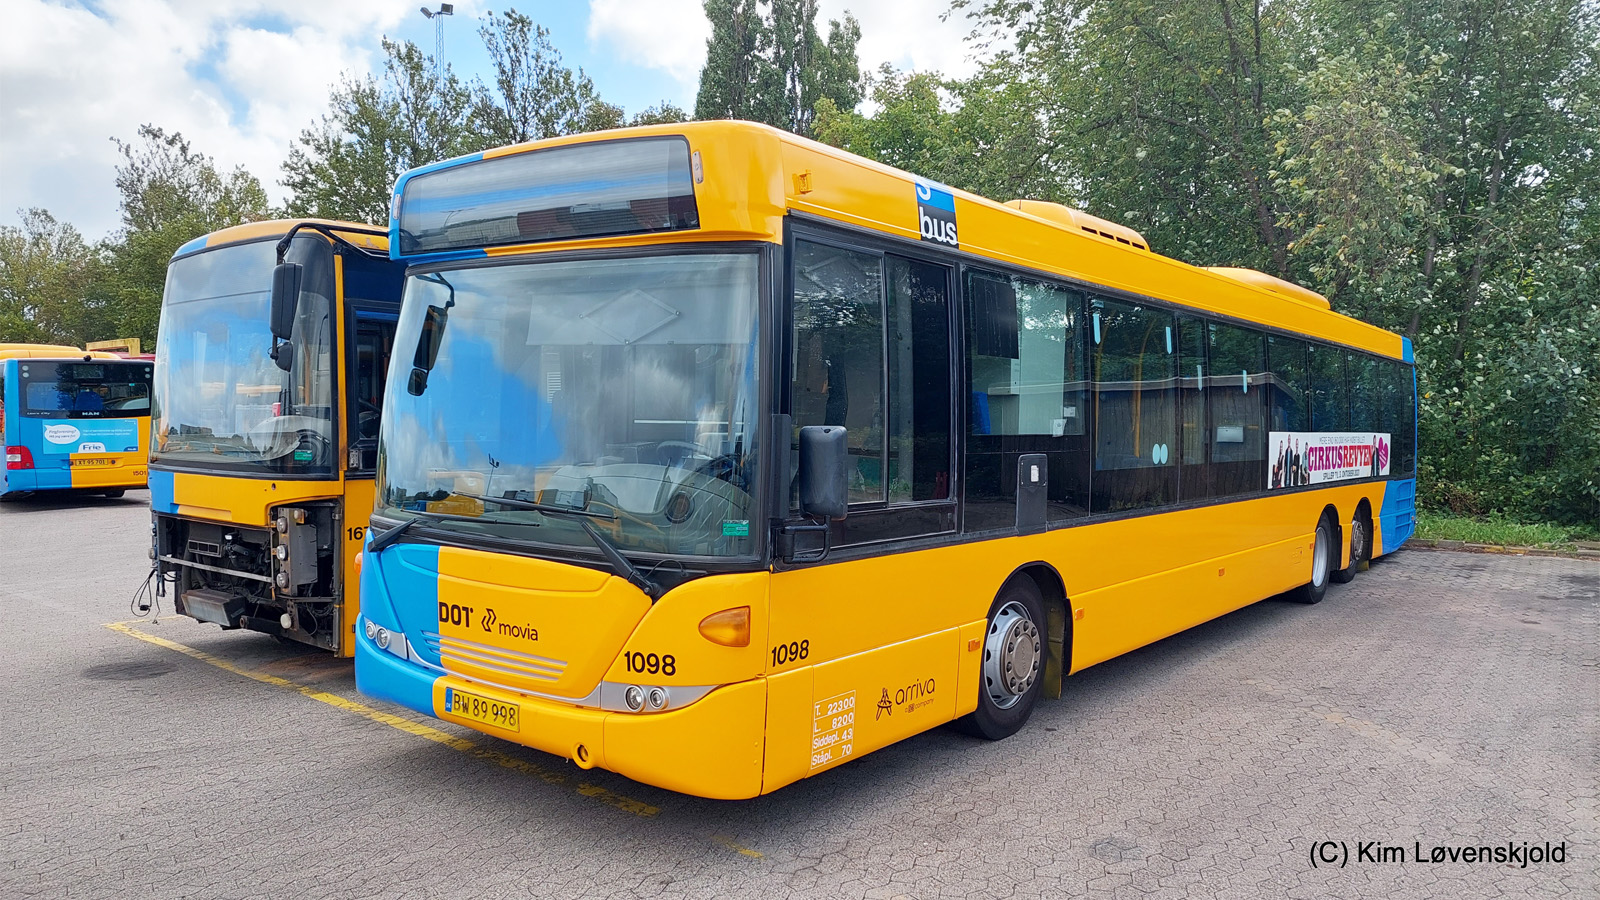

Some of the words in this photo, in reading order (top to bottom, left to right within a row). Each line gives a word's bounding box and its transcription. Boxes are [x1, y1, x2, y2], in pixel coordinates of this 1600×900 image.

[919, 206, 958, 246] bus
[1308, 444, 1374, 472] CIRKUSREVYEN
[347, 526, 370, 541] 16
[438, 601, 474, 628] DOT
[498, 622, 539, 641] movia
[624, 650, 676, 677] 1098
[771, 639, 810, 668] 1098
[895, 678, 936, 706] arriva
[453, 693, 470, 714] BW
[472, 698, 488, 719] 89
[491, 703, 517, 726] 998
[815, 704, 821, 716] T.
[827, 696, 855, 716] 22300
[832, 712, 854, 730] 8200
[813, 731, 840, 750] Siddepl.
[842, 728, 853, 741] 43
[812, 749, 833, 766] Ståpl.
[842, 744, 852, 758] 70
